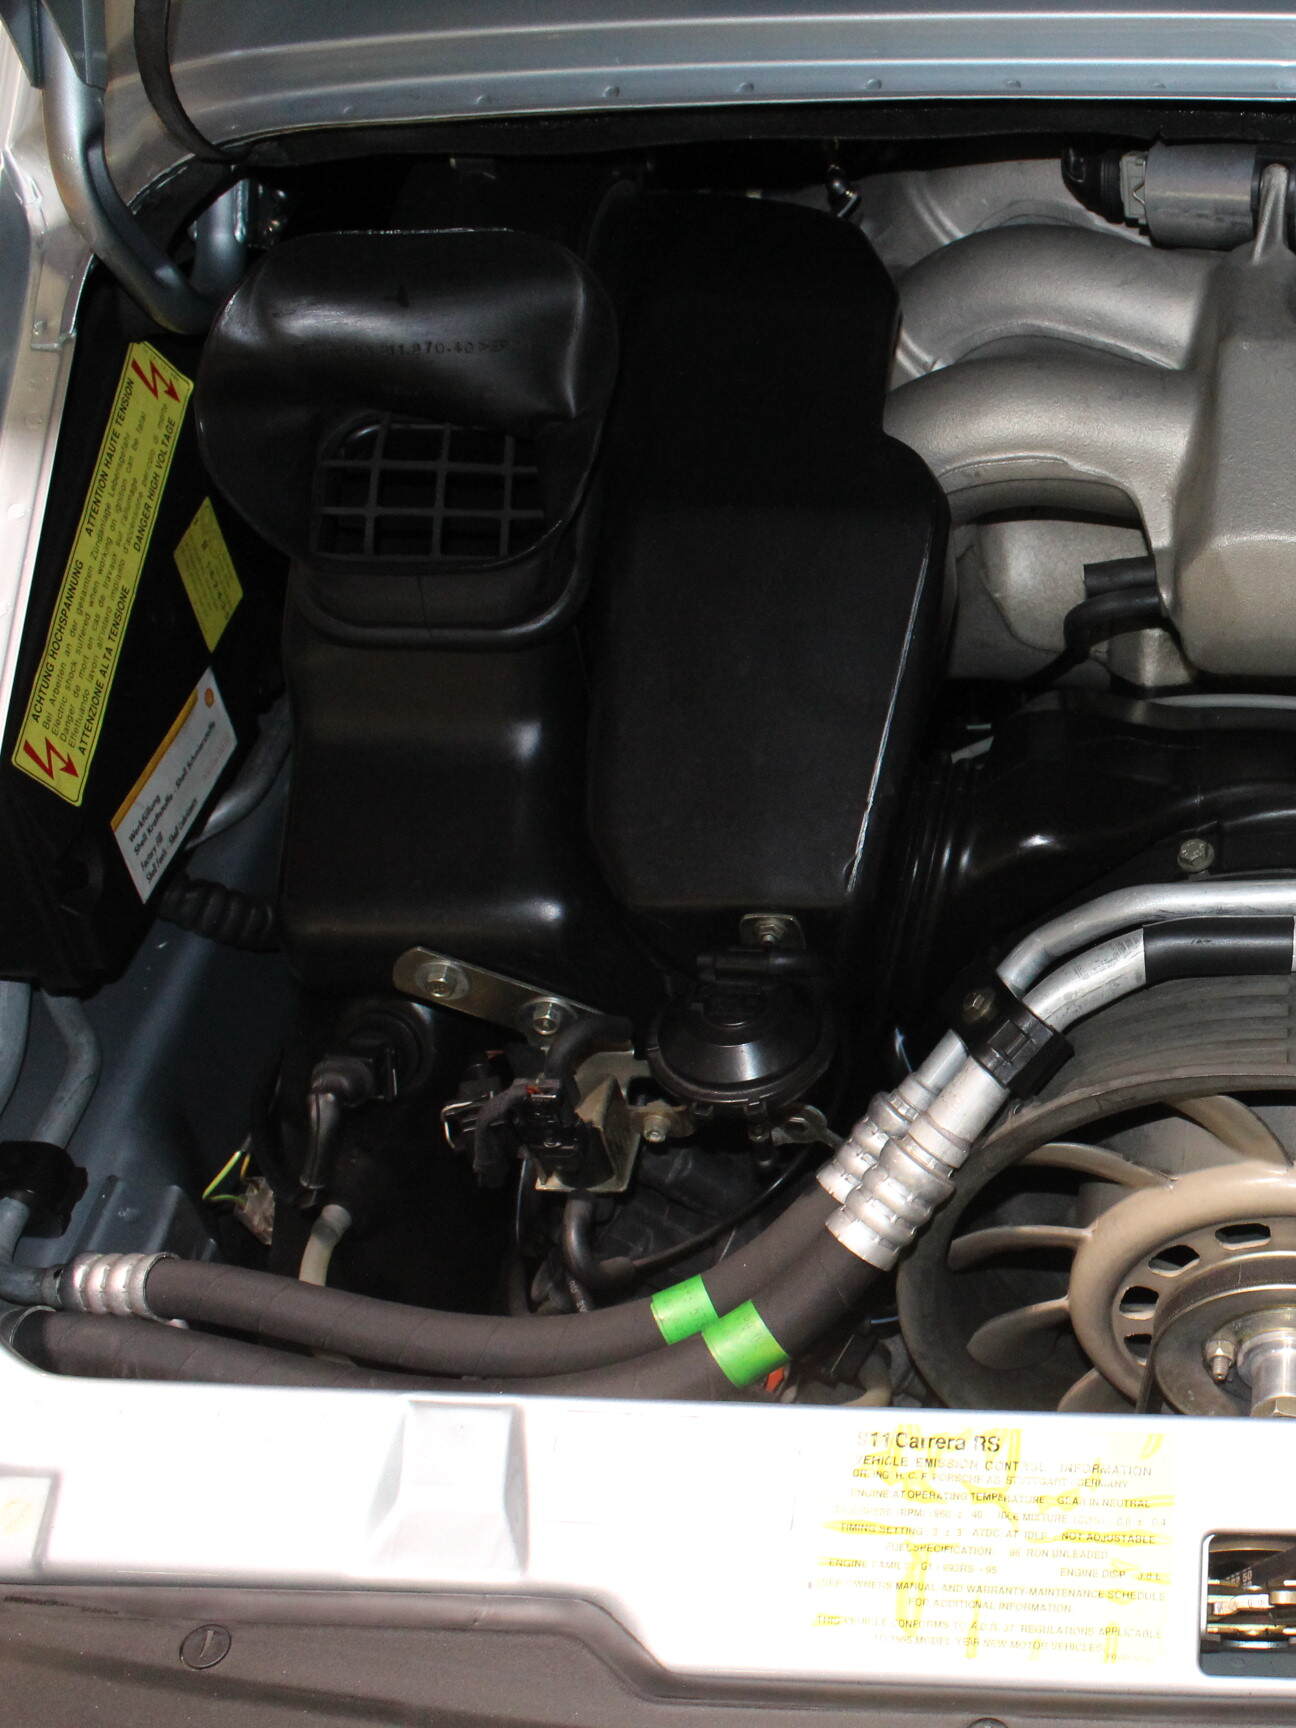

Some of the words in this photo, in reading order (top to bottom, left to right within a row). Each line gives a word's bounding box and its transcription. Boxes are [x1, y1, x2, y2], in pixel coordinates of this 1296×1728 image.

[85, 470, 108, 536] ATTENTION
[103, 428, 120, 469] HAUTE
[115, 377, 133, 425] TENSION
[133, 502, 151, 551] DANGER
[146, 471, 159, 501] HIGH
[155, 416, 175, 469] VOLTAGE
[31, 661, 54, 722] ACHTUNG
[48, 560, 83, 659] HOCHSPANNUNG
[78, 679, 103, 755] ATTENZIONE
[99, 646, 112, 677] ALTA
[107, 585, 129, 641] TENSIONE
[51, 696, 67, 736] Electric
[64, 661, 77, 690] shock
[59, 704, 74, 742] Danger
[857, 1454, 908, 1467] VEHICLE
[1060, 1463, 1152, 1476] INFORMATION
[896, 1431, 966, 1450] Carrera
[974, 1435, 1000, 1452] RS
[1086, 1533, 1156, 1545] ADJUSTABLE
